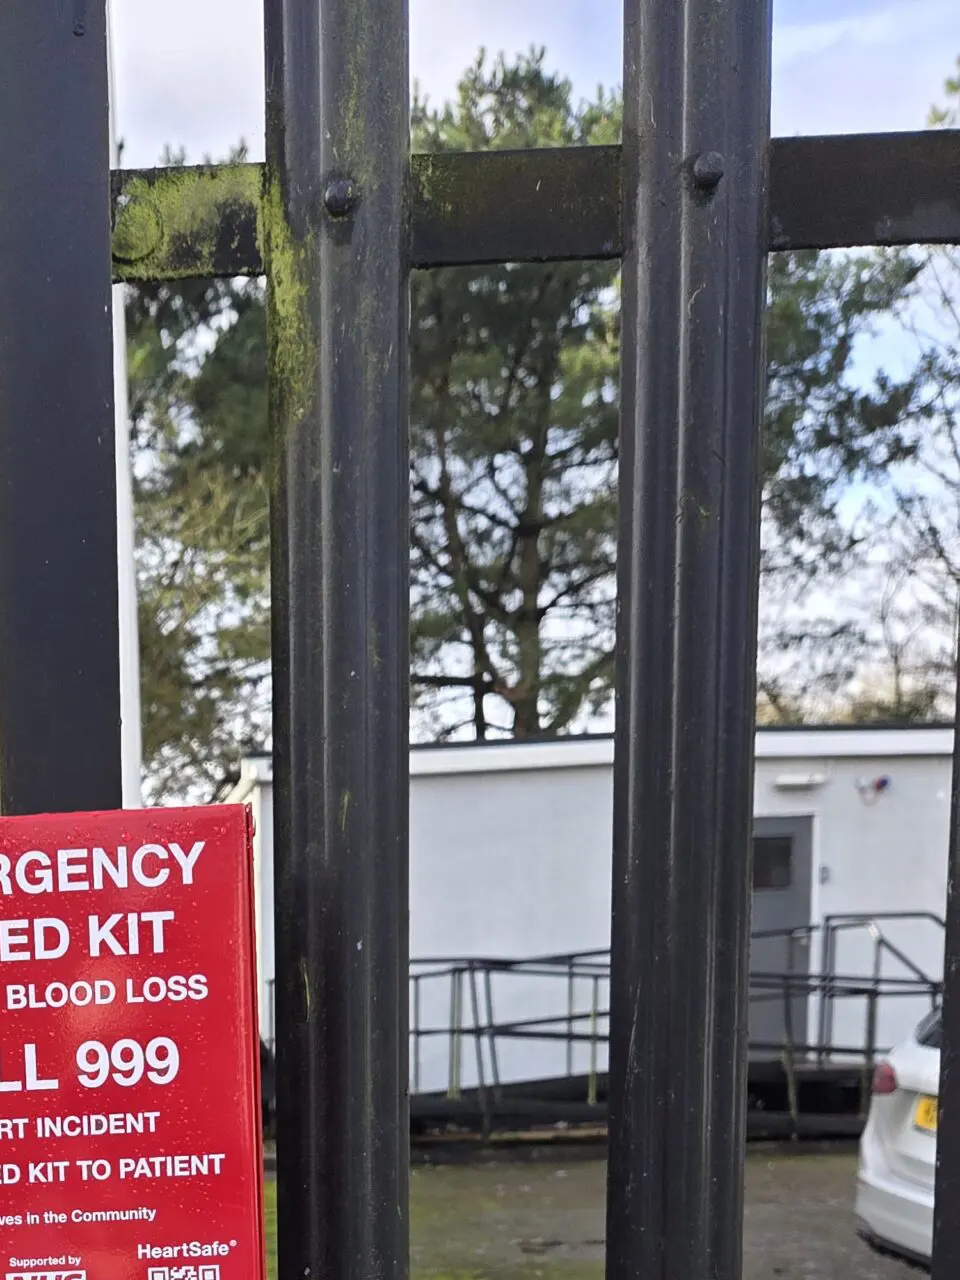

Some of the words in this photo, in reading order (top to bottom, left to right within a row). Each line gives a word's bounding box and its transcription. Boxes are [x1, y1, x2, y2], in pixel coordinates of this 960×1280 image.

[89, 911, 174, 956] KIT
[7, 980, 115, 1009] BLOOD
[127, 975, 208, 1003] LOSS
[76, 1037, 179, 1087] 999
[37, 1112, 160, 1137] INCIDENT
[29, 1161, 69, 1182] KIT
[76, 1160, 111, 1180] TO
[120, 1154, 225, 1178] PATIENT
[27, 1212, 39, 1224] in
[44, 1211, 67, 1223] the
[72, 1208, 156, 1222] Community
[9, 1256, 67, 1269] Supported
[68, 1255, 81, 1267] by
